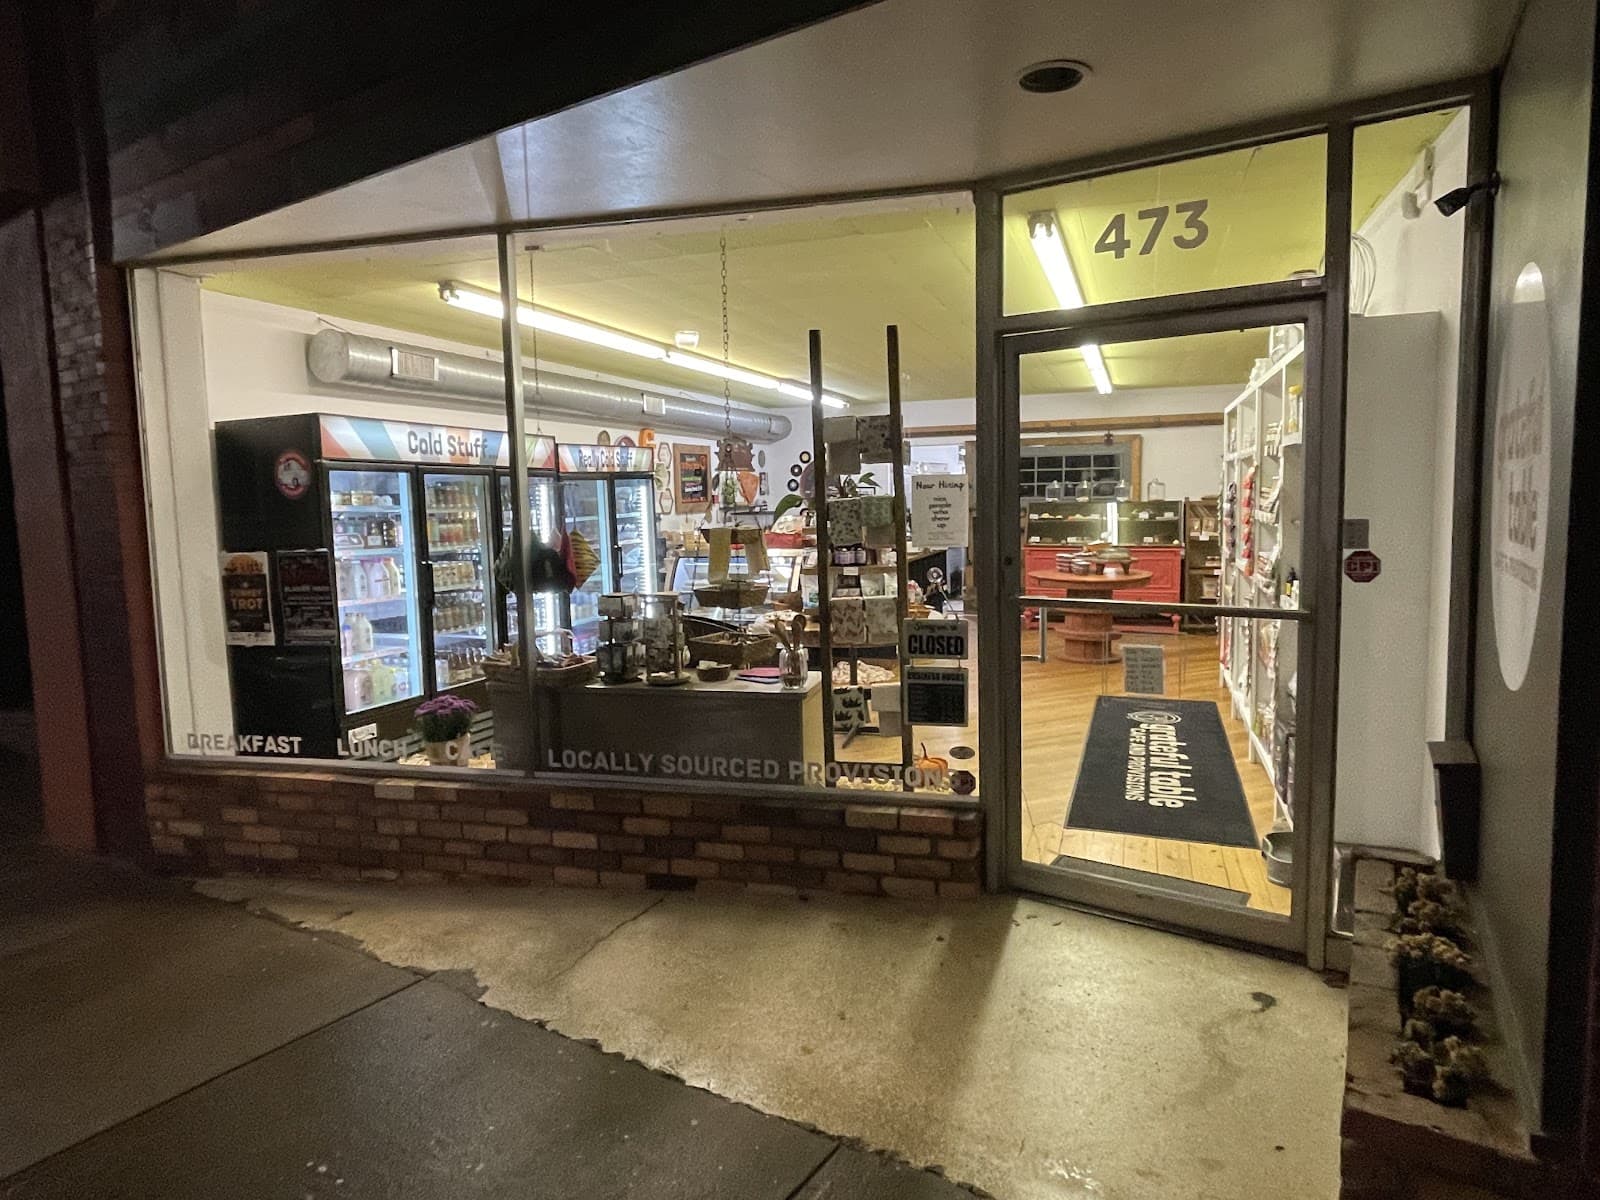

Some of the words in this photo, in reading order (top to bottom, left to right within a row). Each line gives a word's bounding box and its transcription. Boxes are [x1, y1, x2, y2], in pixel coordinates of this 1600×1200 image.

[1095, 199, 1208, 259] 473
[407, 430, 442, 456] Cold
[230, 597, 264, 610] TROT
[908, 634, 965, 655] CLOSED
[187, 733, 302, 755] BREAKFAST
[336, 737, 408, 760] LUNCH
[1140, 723, 1193, 770] grateful
[548, 748, 655, 773] LOCALLY
[659, 754, 780, 779] SOURCED
[1124, 755, 1146, 801] PROVISIONS
[1149, 771, 1198, 808] table
